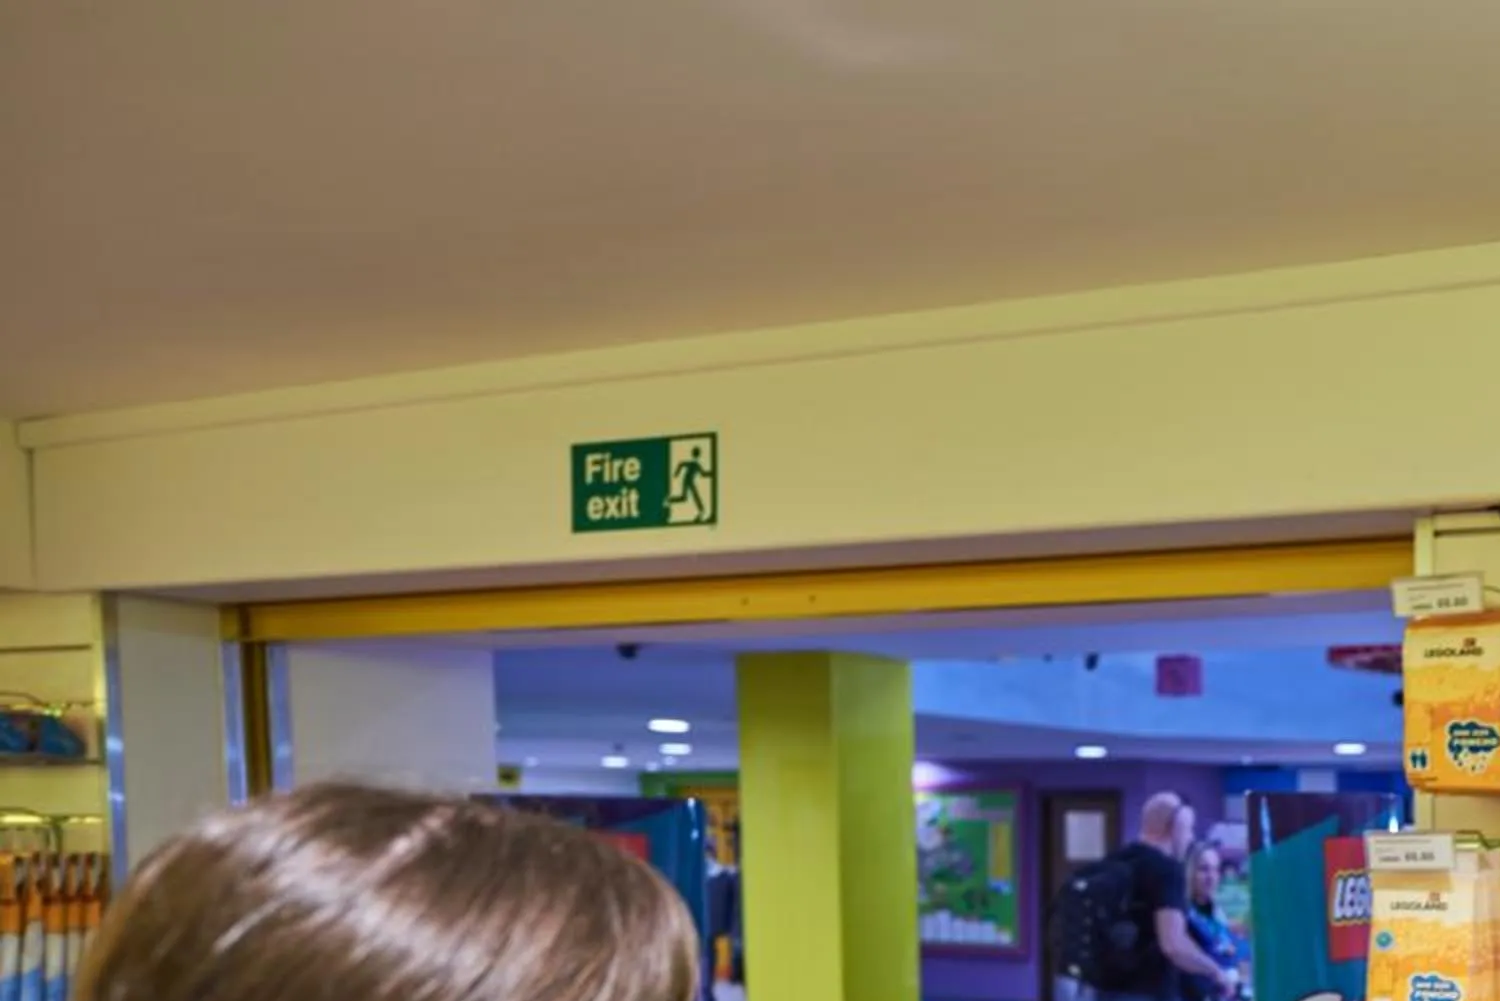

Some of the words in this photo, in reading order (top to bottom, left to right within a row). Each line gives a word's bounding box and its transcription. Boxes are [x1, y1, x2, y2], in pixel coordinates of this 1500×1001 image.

[585, 452, 641, 484] Fire
[587, 487, 640, 520] exit
[1332, 873, 1373, 921] LEG
